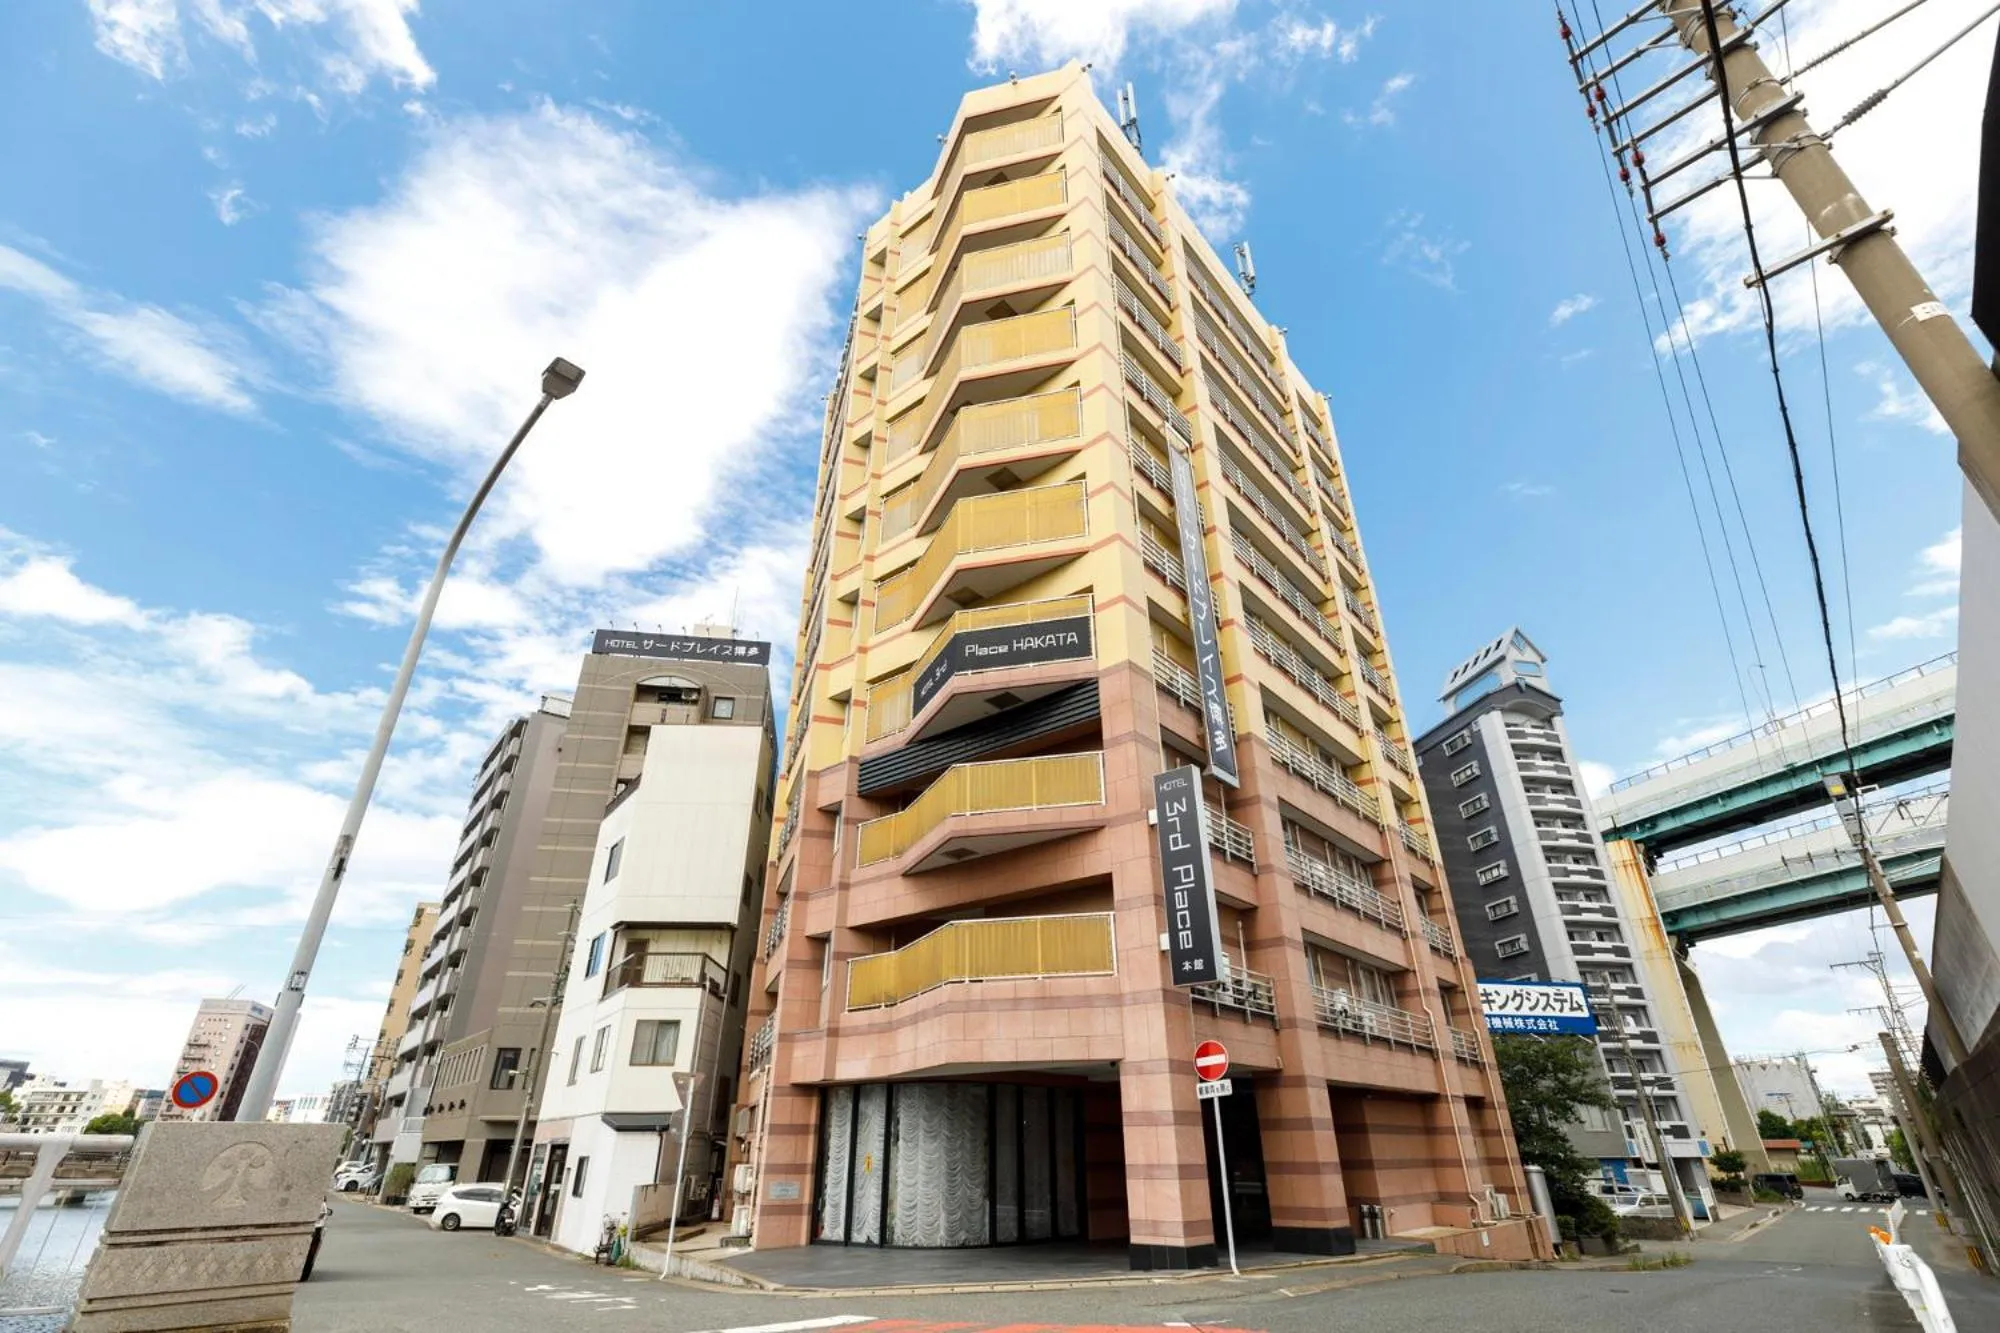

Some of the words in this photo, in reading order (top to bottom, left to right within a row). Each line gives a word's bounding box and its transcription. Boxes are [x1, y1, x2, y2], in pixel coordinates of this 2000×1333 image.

[605, 638, 639, 650] HOTEL
[643, 639, 760, 657] サードプレイス博多
[964, 644, 1009, 657] Place
[1012, 632, 1079, 652] HAKATA
[1159, 778, 1189, 792] HOTEL
[1165, 796, 1192, 851] 3rd
[1172, 863, 1196, 950] Place
[1181, 958, 1204, 972] 本館
[1480, 988, 1585, 1013] キングシステム
